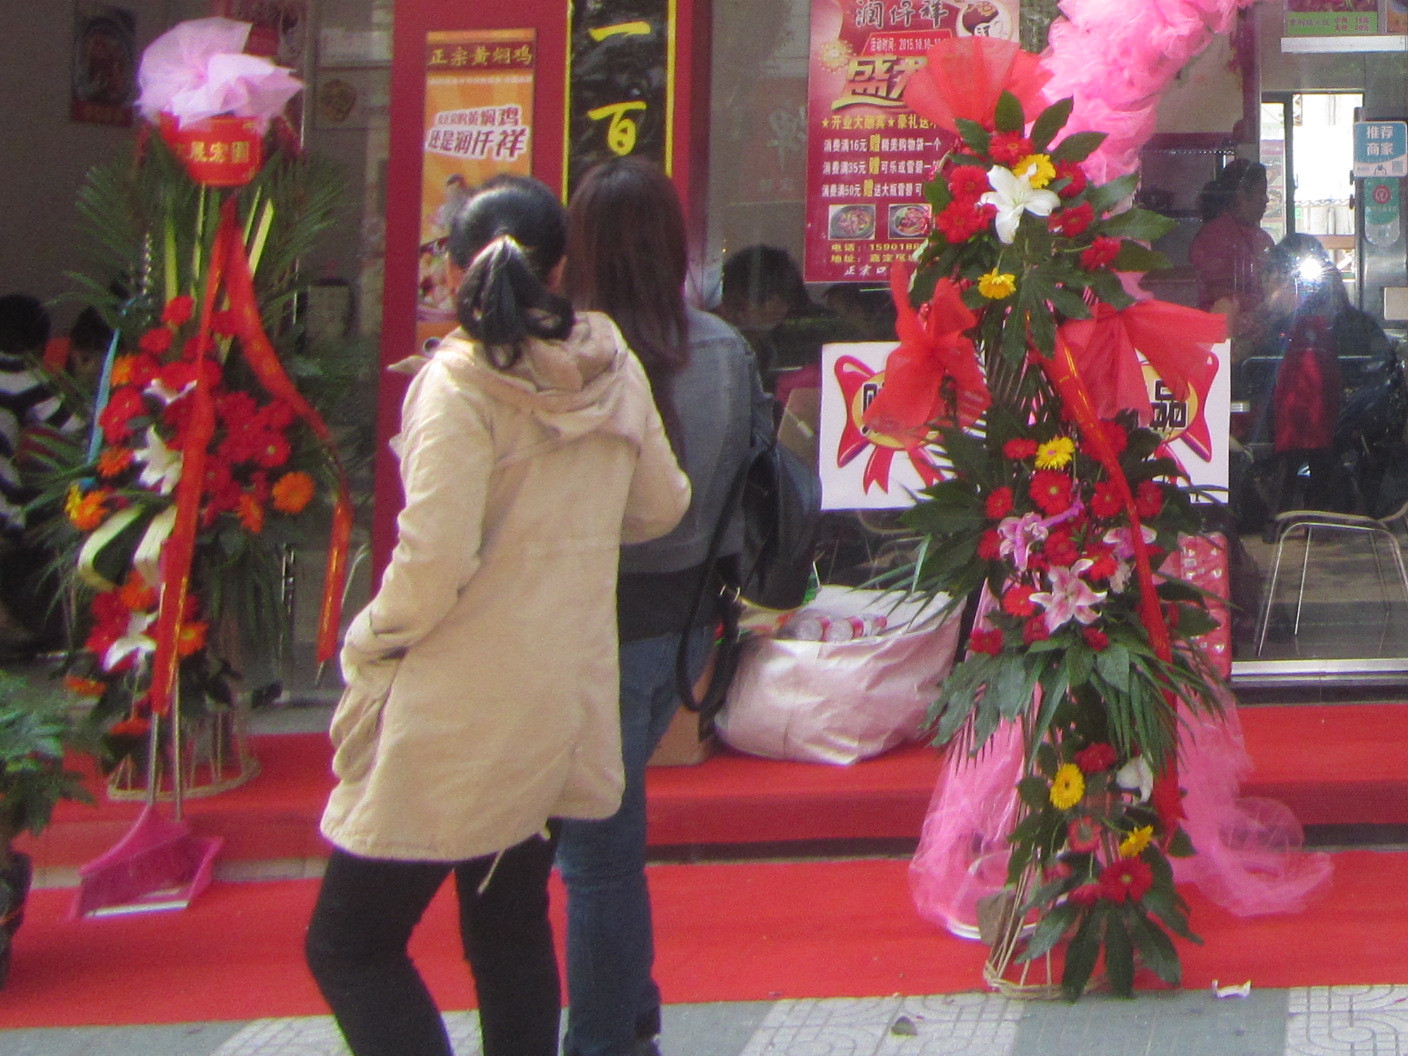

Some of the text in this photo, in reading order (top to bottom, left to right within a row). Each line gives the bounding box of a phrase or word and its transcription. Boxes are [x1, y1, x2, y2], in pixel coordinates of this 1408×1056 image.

[428, 45, 533, 67] 正宗黄焖鸡
[1366, 125, 1394, 140] 推荐
[1366, 142, 1394, 157] 商家
